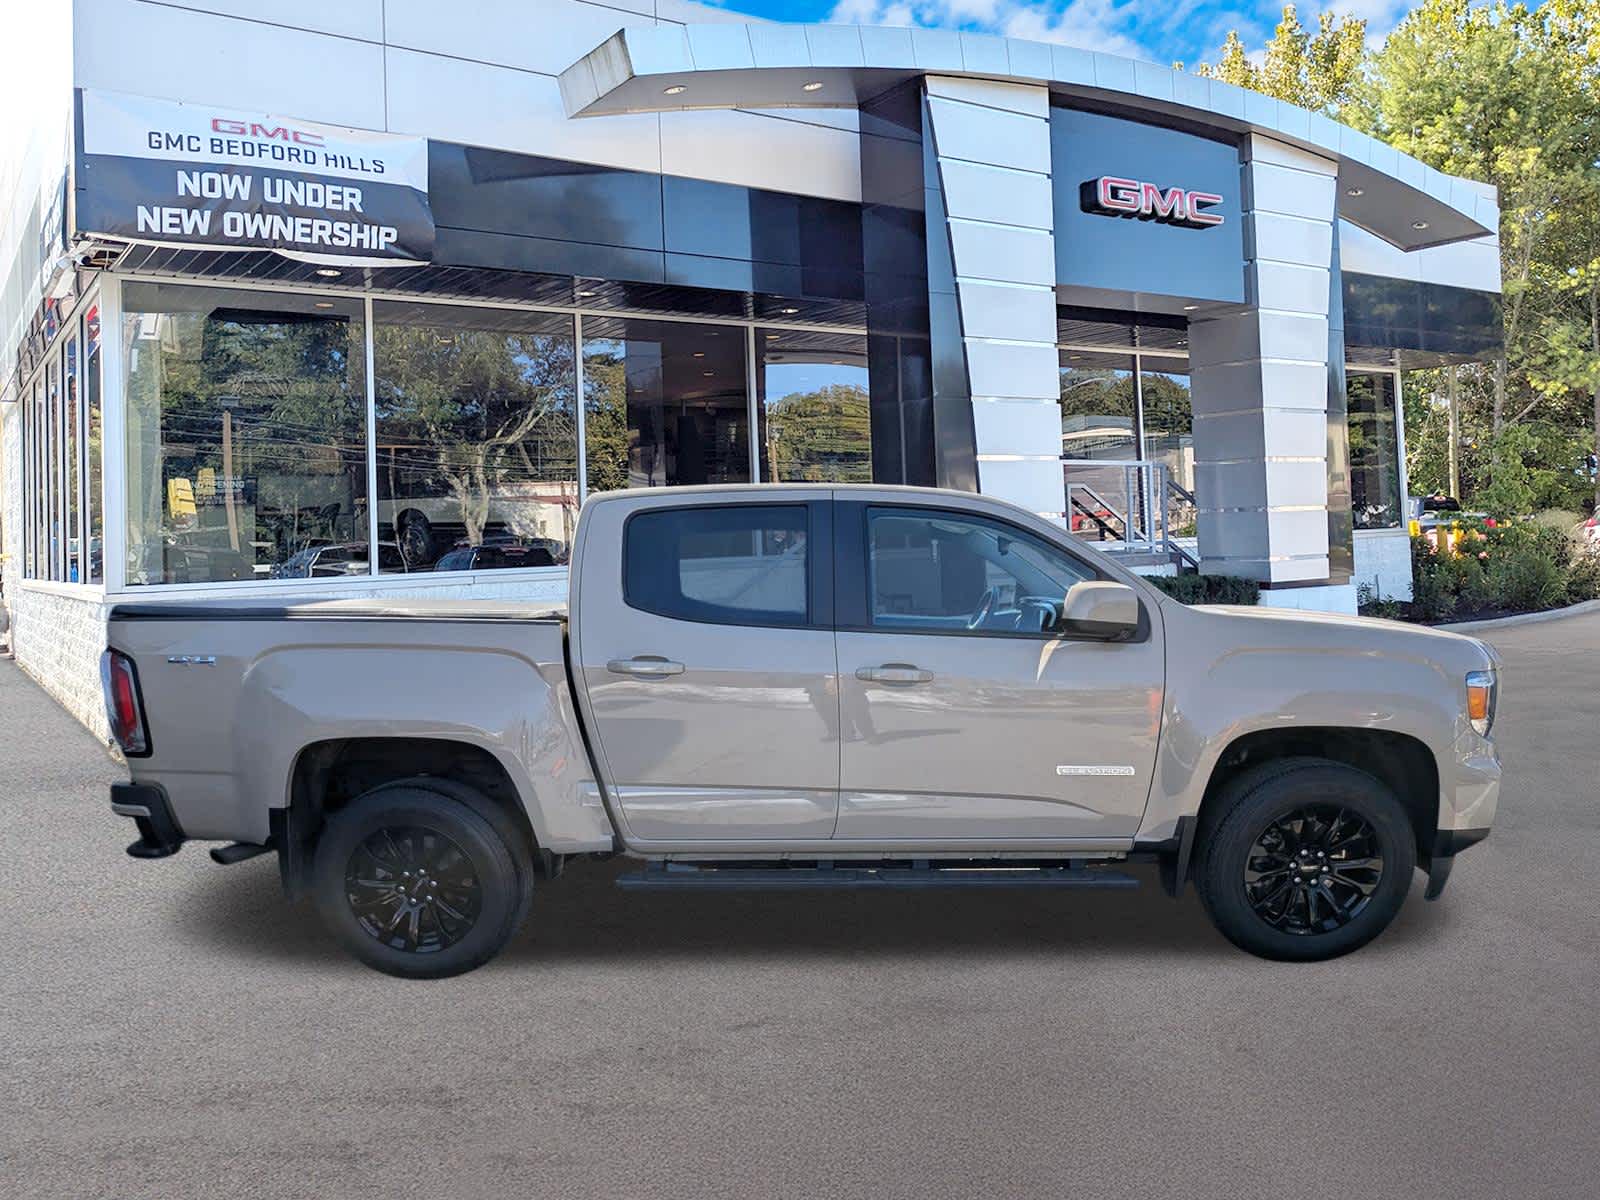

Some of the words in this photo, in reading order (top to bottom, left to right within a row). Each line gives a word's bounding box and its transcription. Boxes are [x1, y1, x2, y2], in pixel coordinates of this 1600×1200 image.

[148, 131, 201, 153] GMC
[210, 139, 317, 165] BEDFORD
[325, 154, 385, 174] HILLS
[211, 118, 326, 148] GMC
[177, 170, 252, 201] NOW
[263, 176, 364, 213] UNDER
[1097, 175, 1225, 225] GMC
[136, 205, 211, 236] NEW
[223, 210, 398, 250] OWNERSHIP
